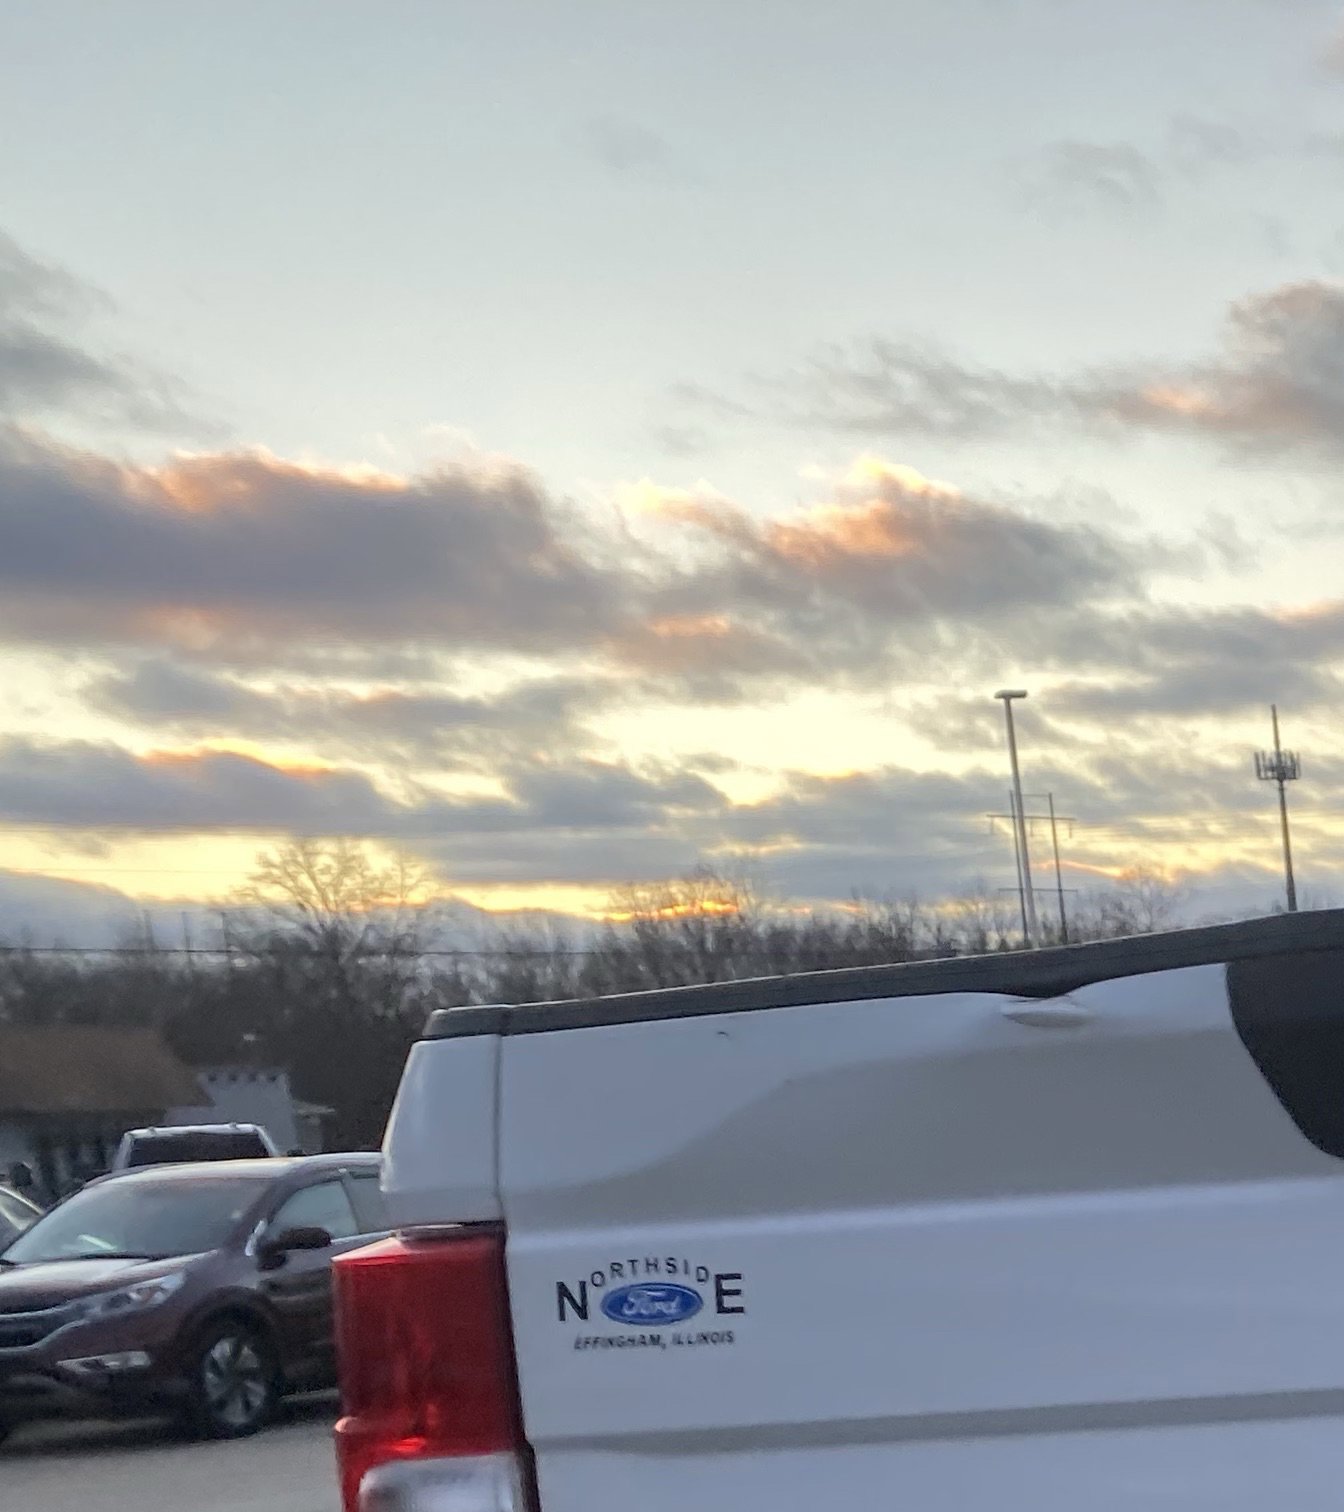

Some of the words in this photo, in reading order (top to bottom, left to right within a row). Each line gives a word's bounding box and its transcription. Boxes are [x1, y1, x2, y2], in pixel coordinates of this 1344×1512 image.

[556, 1257, 745, 1322] NORTHSIDE
[621, 1290, 681, 1316] Ford
[574, 1334, 666, 1350] EFFINGHAM,
[672, 1331, 735, 1345] ILLINOIS
